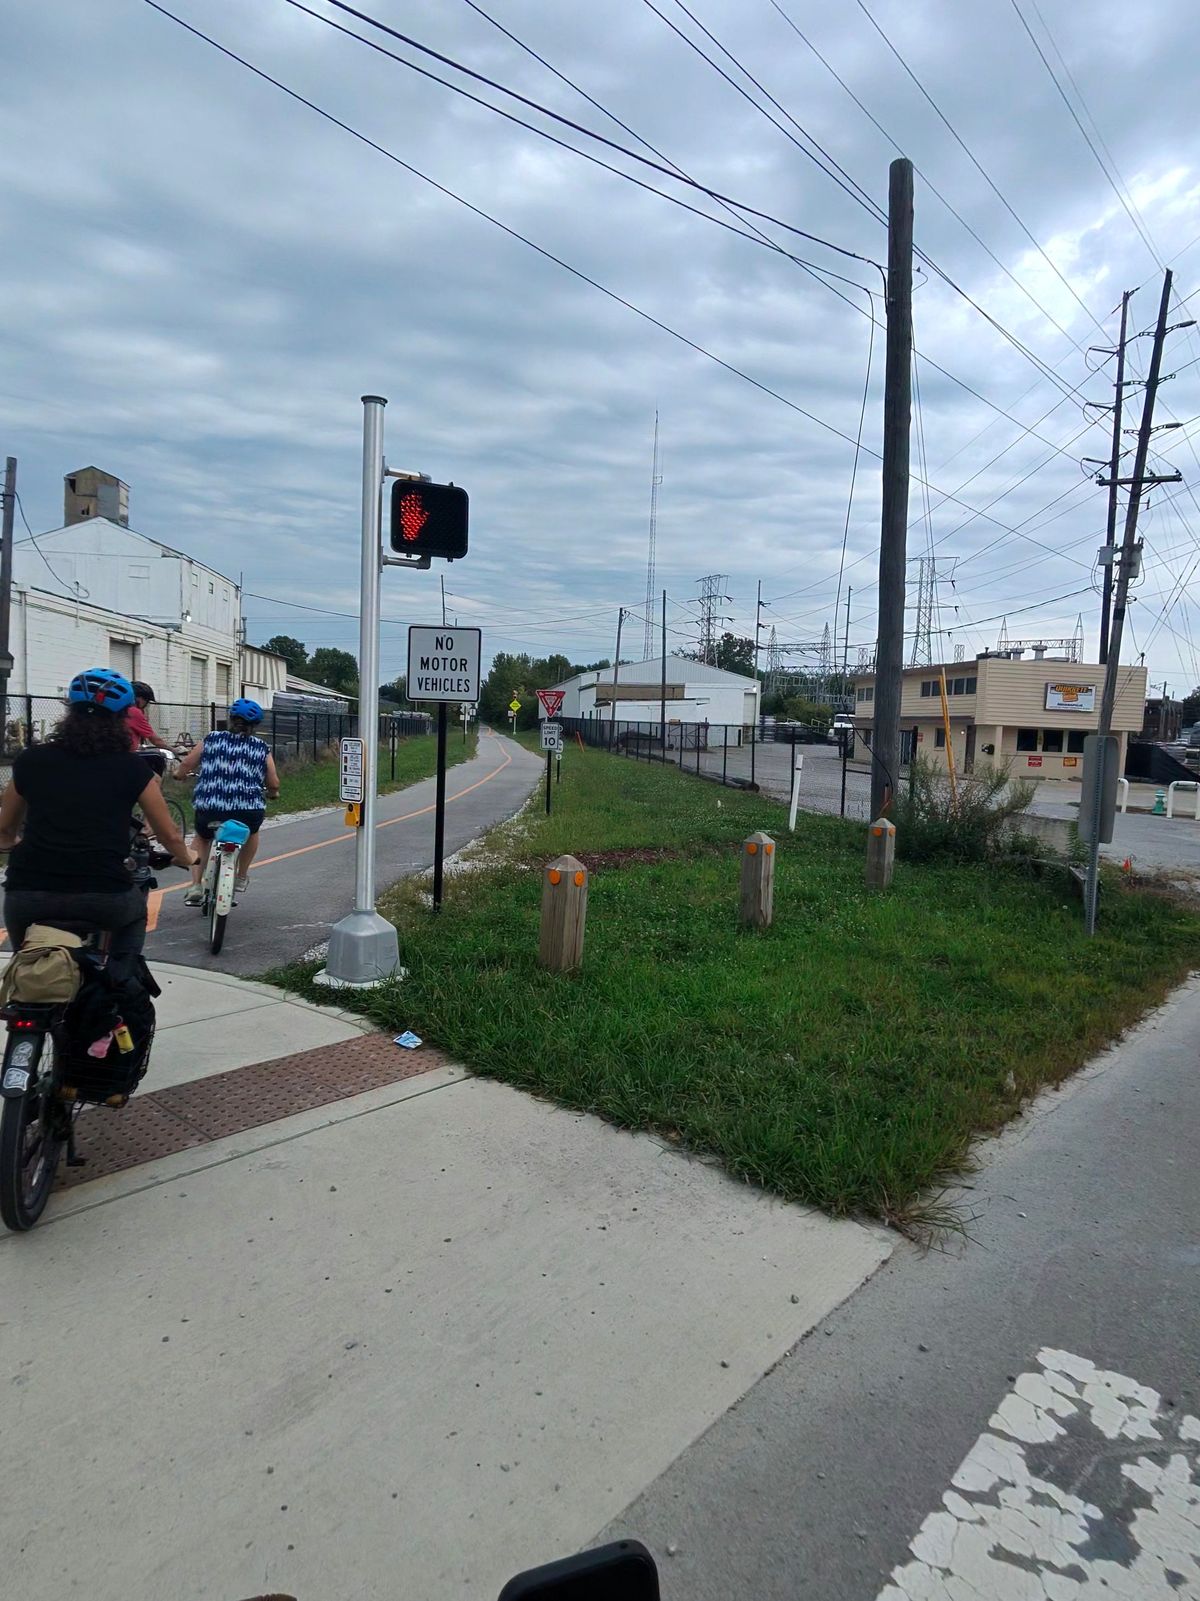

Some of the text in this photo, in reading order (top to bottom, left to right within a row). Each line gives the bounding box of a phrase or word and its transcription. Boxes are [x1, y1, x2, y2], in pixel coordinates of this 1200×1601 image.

[435, 636, 454, 651] NO
[420, 656, 468, 672] MOTOR
[417, 677, 470, 693] VEHICLES
[544, 737, 556, 746] 10
